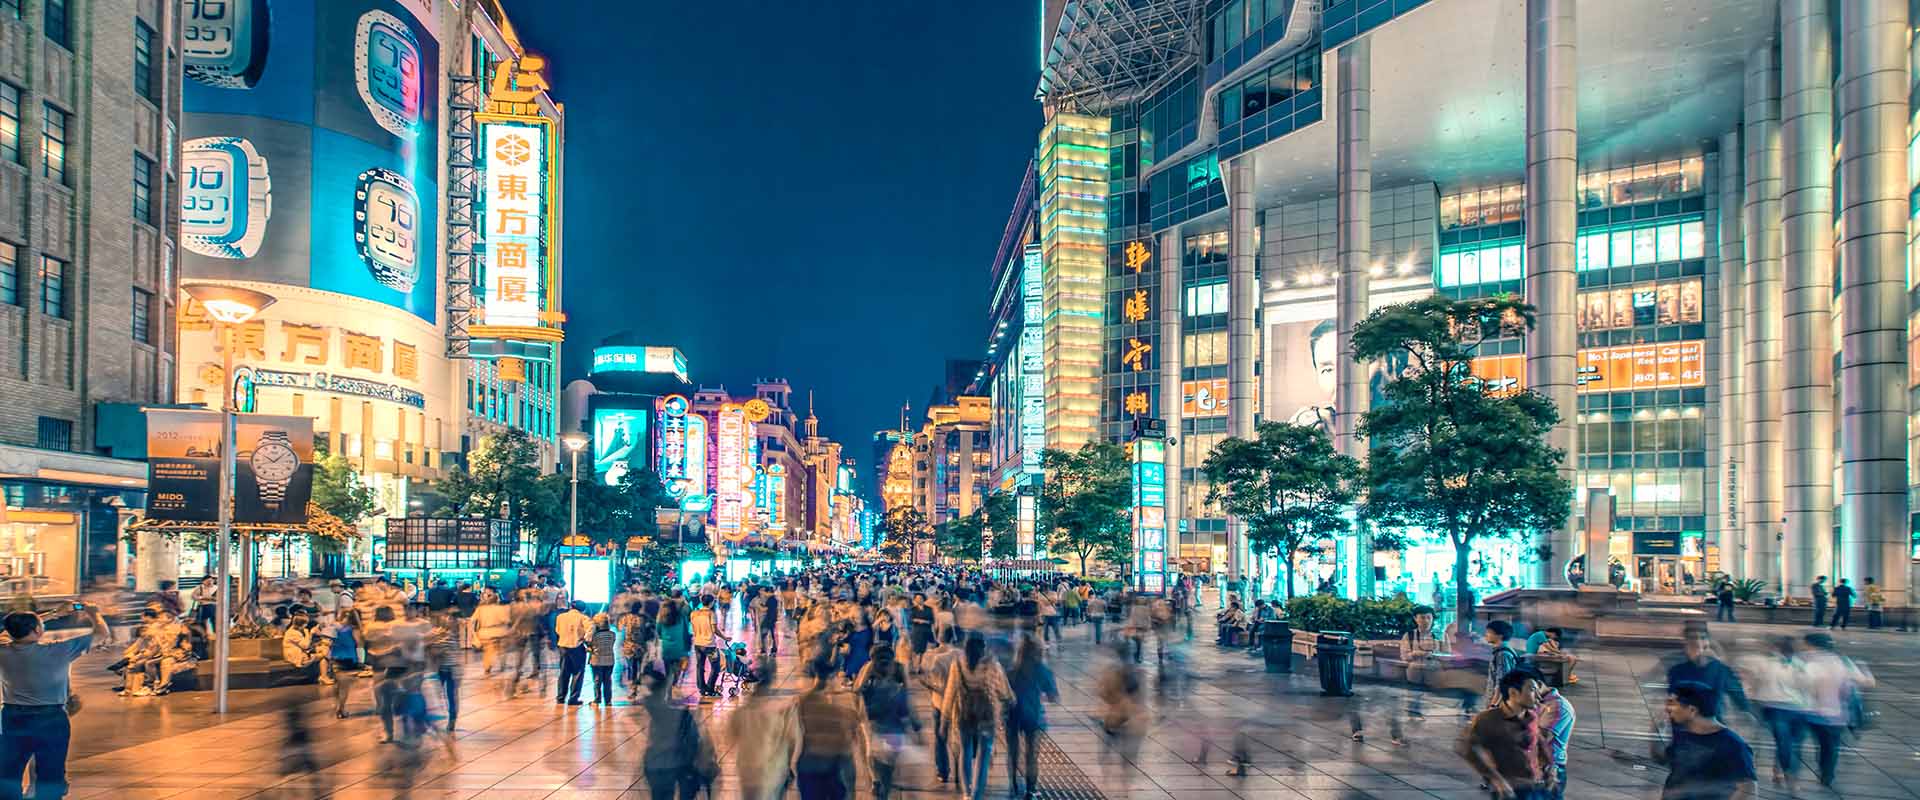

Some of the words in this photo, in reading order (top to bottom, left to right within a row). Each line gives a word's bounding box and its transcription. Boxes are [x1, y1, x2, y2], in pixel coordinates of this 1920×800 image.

[496, 174, 528, 303] 東方商厦
[156, 431, 179, 440] 2012
[157, 493, 184, 501] MIDO
